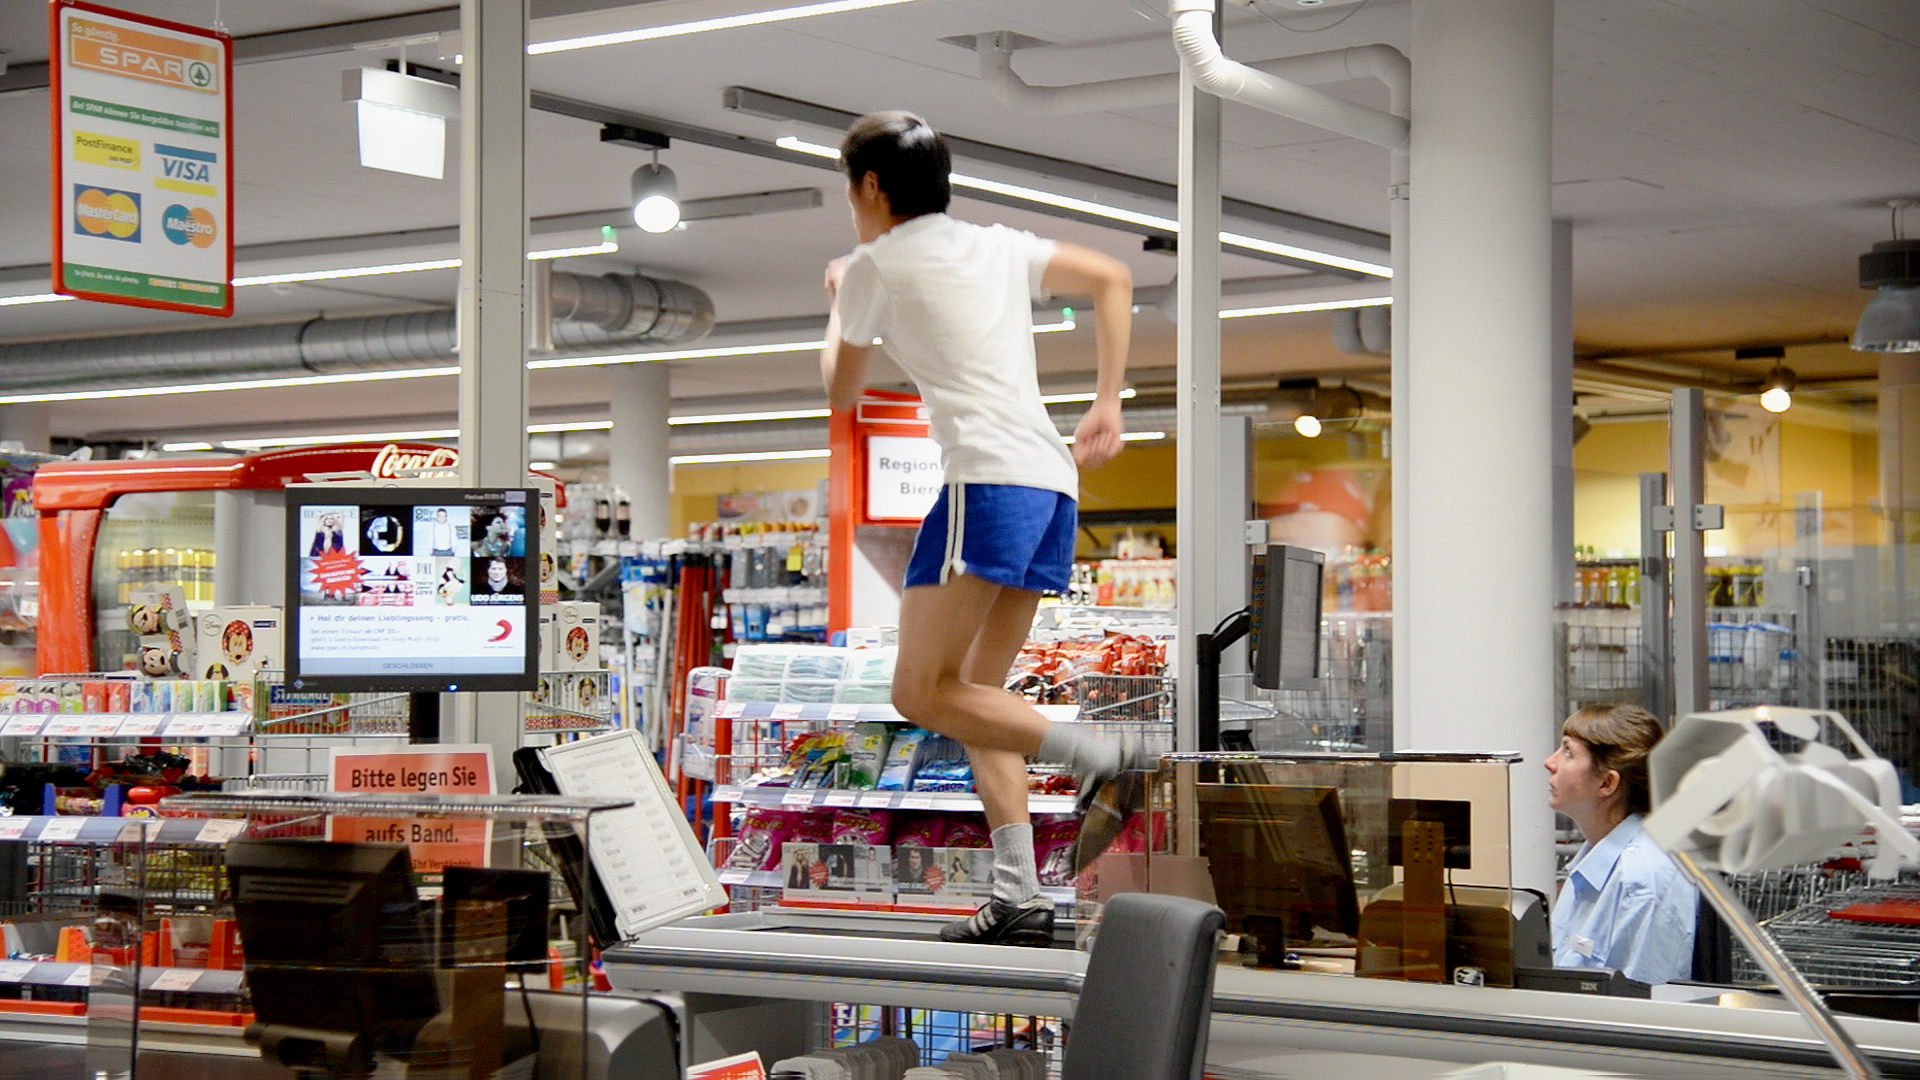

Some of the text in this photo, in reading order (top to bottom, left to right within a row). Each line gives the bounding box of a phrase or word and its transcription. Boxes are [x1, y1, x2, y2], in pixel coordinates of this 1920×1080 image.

[71, 22, 83, 33] So
[99, 47, 183, 78] SPAR
[85, 102, 103, 113] SPAR
[129, 110, 141, 120] Sie
[76, 136, 133, 154] PostFinance
[161, 157, 210, 183] VISA
[76, 203, 138, 224] MasterCard
[166, 217, 213, 235] Maestro
[317, 614, 332, 622] Hol
[334, 614, 346, 622] dir
[347, 614, 376, 622] deinen
[378, 614, 434, 623] Lieblingssong
[444, 614, 470, 623] gratis.
[382, 662, 434, 670] GESCHLOSSEN
[351, 766, 477, 791] Bitte legen Sie
[365, 823, 459, 843] aufs Band.
[1581, 981, 1598, 992] IBM
